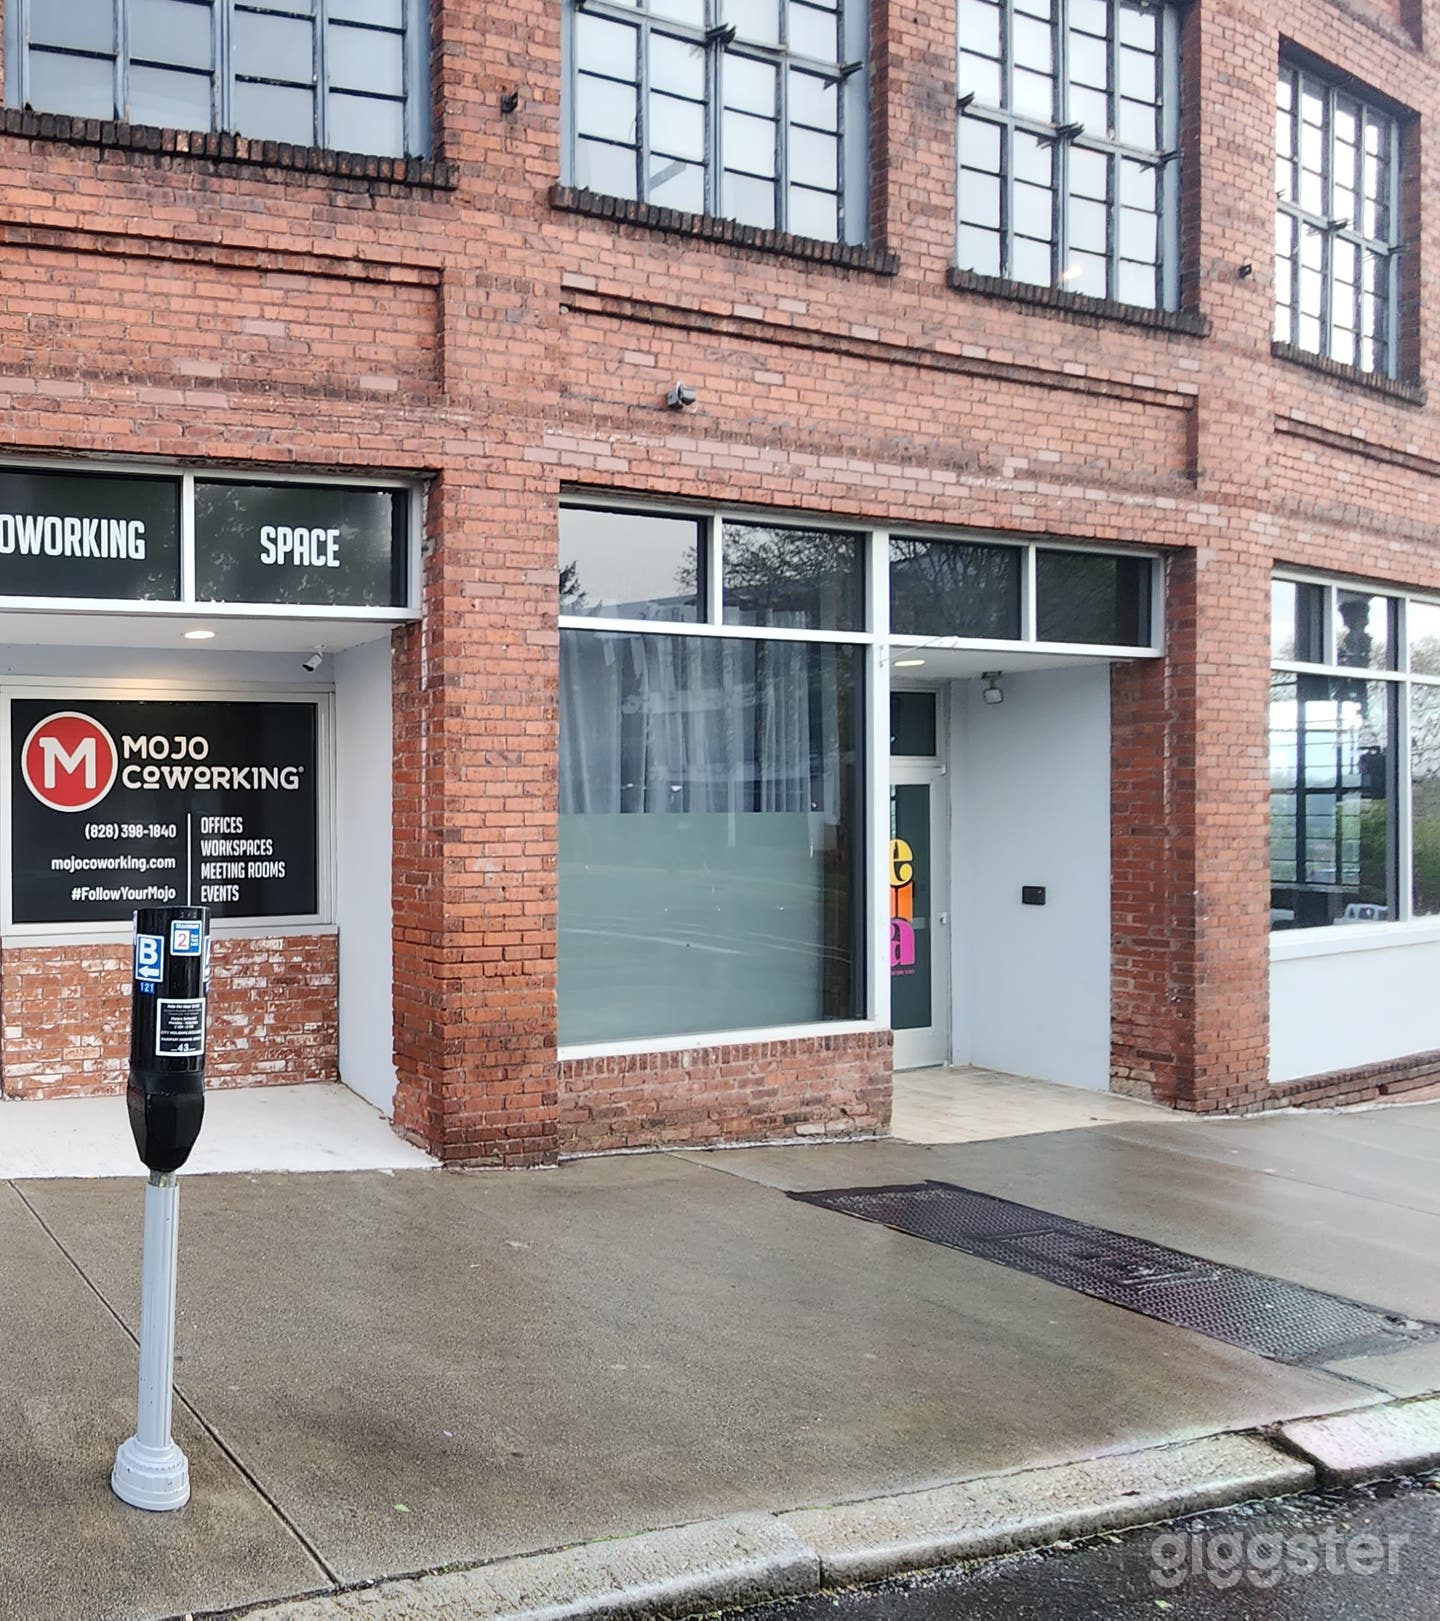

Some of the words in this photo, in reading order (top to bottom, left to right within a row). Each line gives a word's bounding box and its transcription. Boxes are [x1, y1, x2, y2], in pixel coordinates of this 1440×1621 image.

[260, 525, 340, 568] SPACE
[121, 735, 209, 761] MOJO
[39, 737, 96, 789] M
[85, 823, 120, 840] (828)
[120, 823, 177, 839] 398-1840
[200, 816, 244, 835] OFFICES
[200, 838, 273, 857] WORKSPACES
[50, 855, 176, 874] mojocoworking.com
[200, 861, 245, 880] MEETING
[247, 861, 286, 879] ROOMS
[71, 885, 177, 904] #FollowYourMojo
[200, 884, 240, 903] EVENTS
[177, 932, 188, 948] 2
[140, 938, 158, 965] B
[140, 982, 155, 992] 121
[177, 1043, 189, 1052] 43
